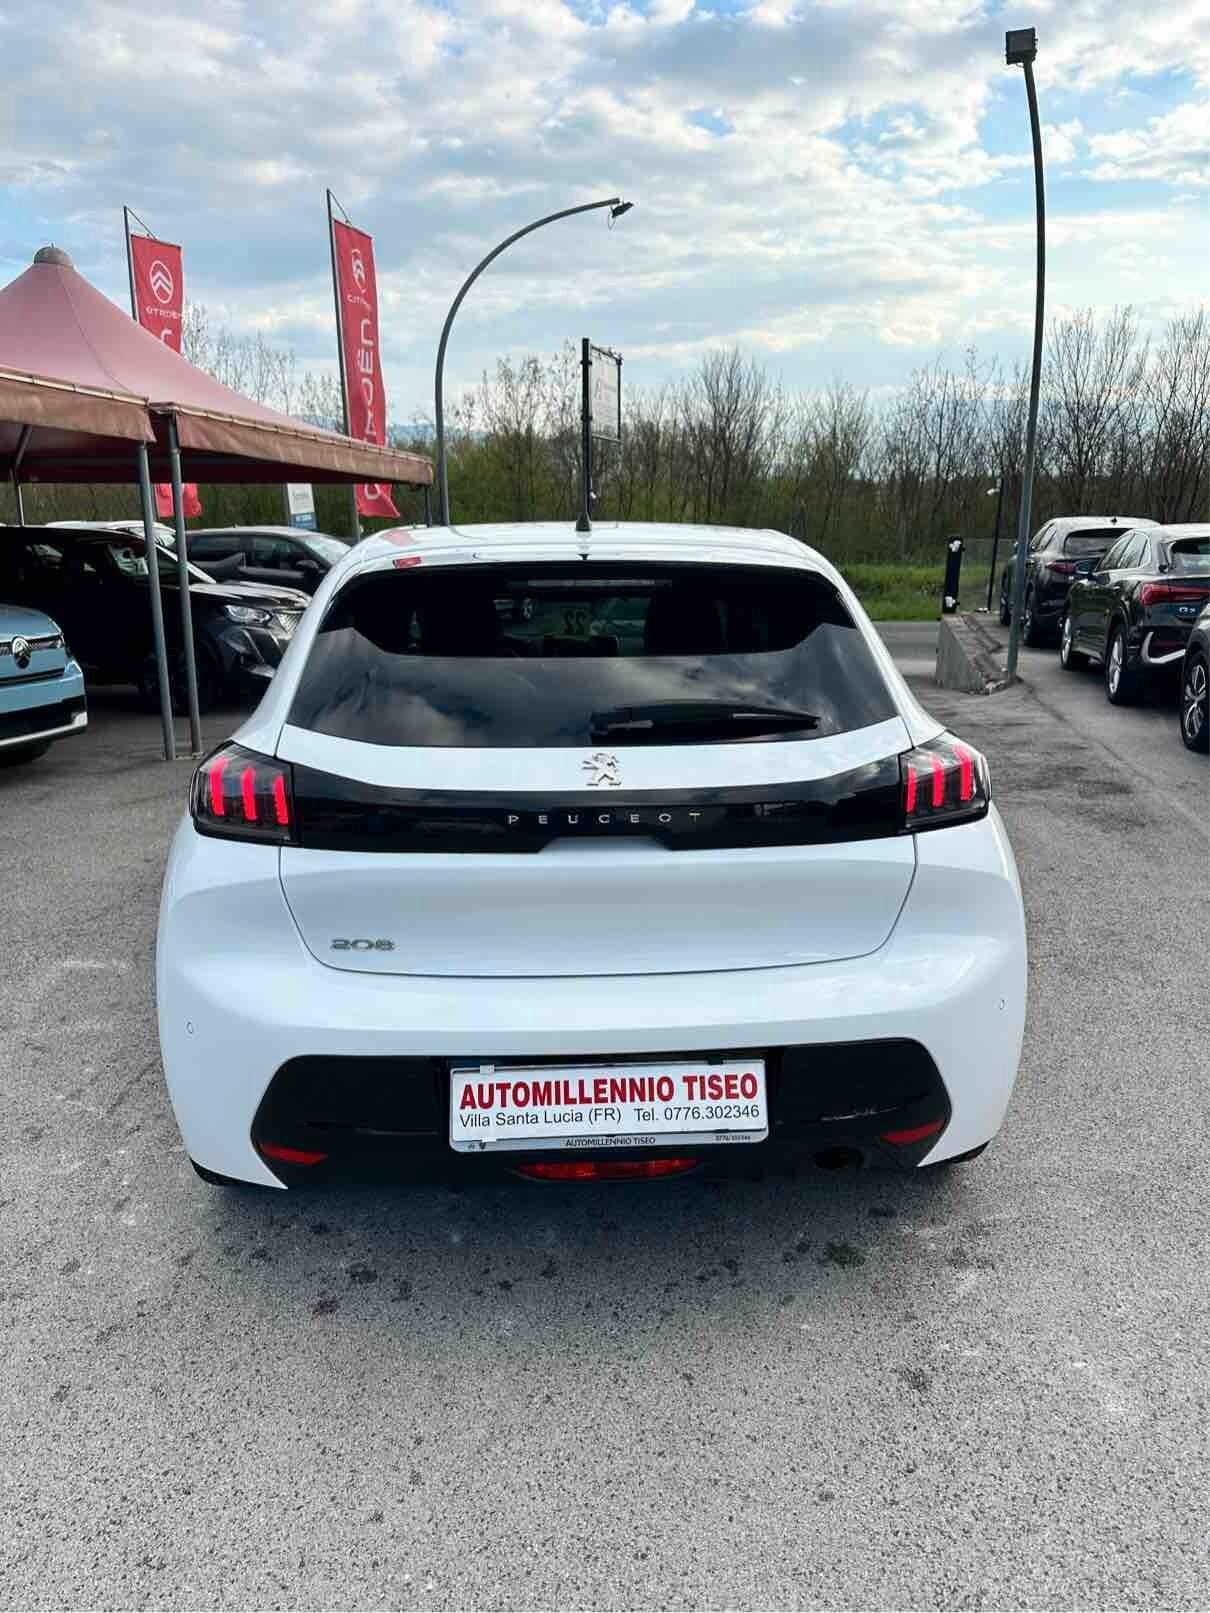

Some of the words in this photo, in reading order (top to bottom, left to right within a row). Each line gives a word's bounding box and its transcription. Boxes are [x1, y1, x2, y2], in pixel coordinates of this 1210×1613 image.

[508, 812, 701, 824] PEUGEOT
[330, 938, 395, 951] 208
[460, 1076, 674, 1109] AUTOMILLENNIO
[682, 1073, 758, 1101] TISEO
[459, 1112, 490, 1128] Villa
[495, 1111, 539, 1126] Santa
[543, 1109, 583, 1124] Lucia
[588, 1107, 622, 1125] (FR)
[633, 1107, 660, 1122] Tel.
[663, 1104, 760, 1121] 0776.302346
[566, 1136, 632, 1147] AUTOMILLENNIO
[633, 1136, 656, 1146] TISEO
